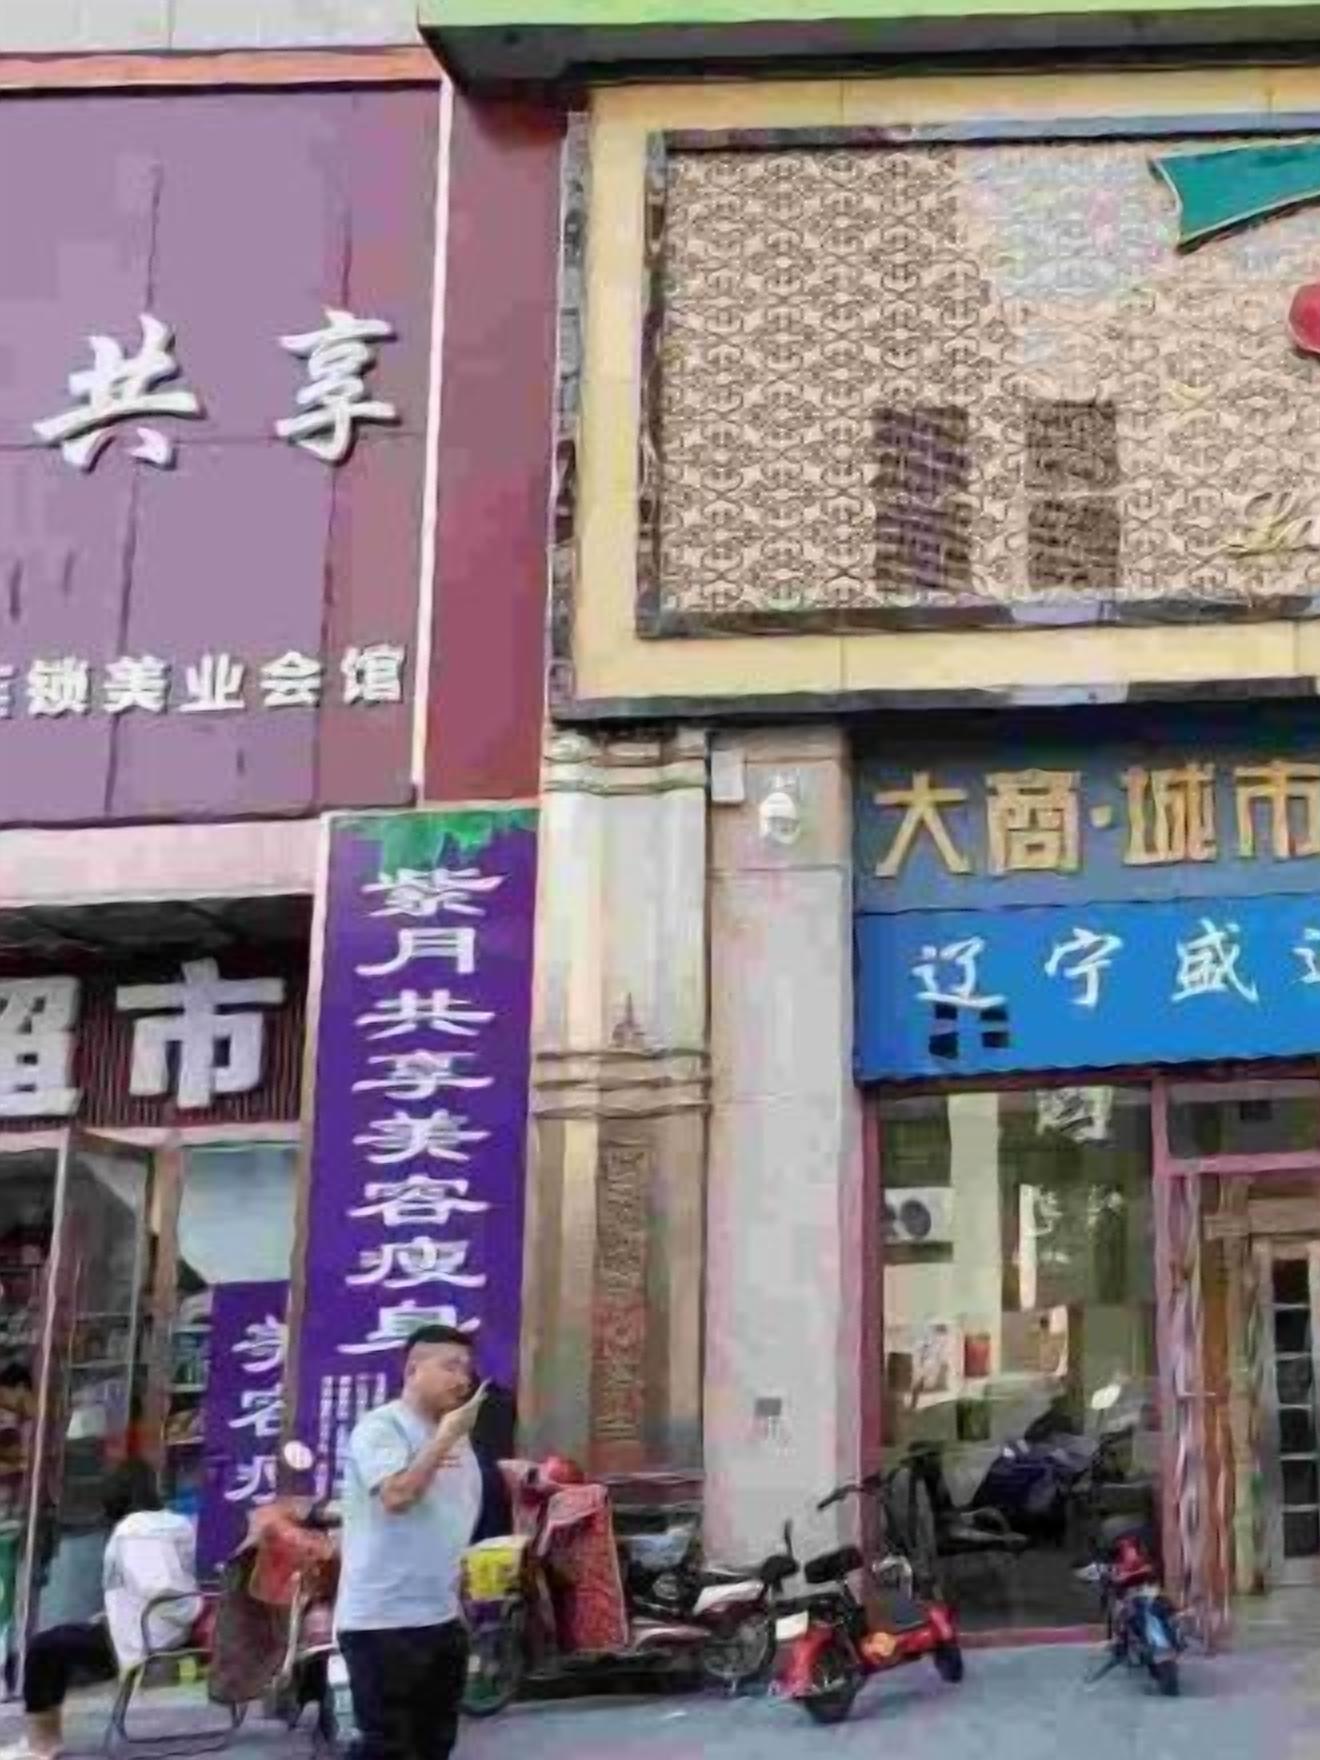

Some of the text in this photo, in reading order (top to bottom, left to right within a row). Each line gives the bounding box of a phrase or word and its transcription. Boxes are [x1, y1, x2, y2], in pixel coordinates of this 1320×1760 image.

[33, 306, 398, 470] 共享
[0, 644, 405, 716] 锁美业会馆
